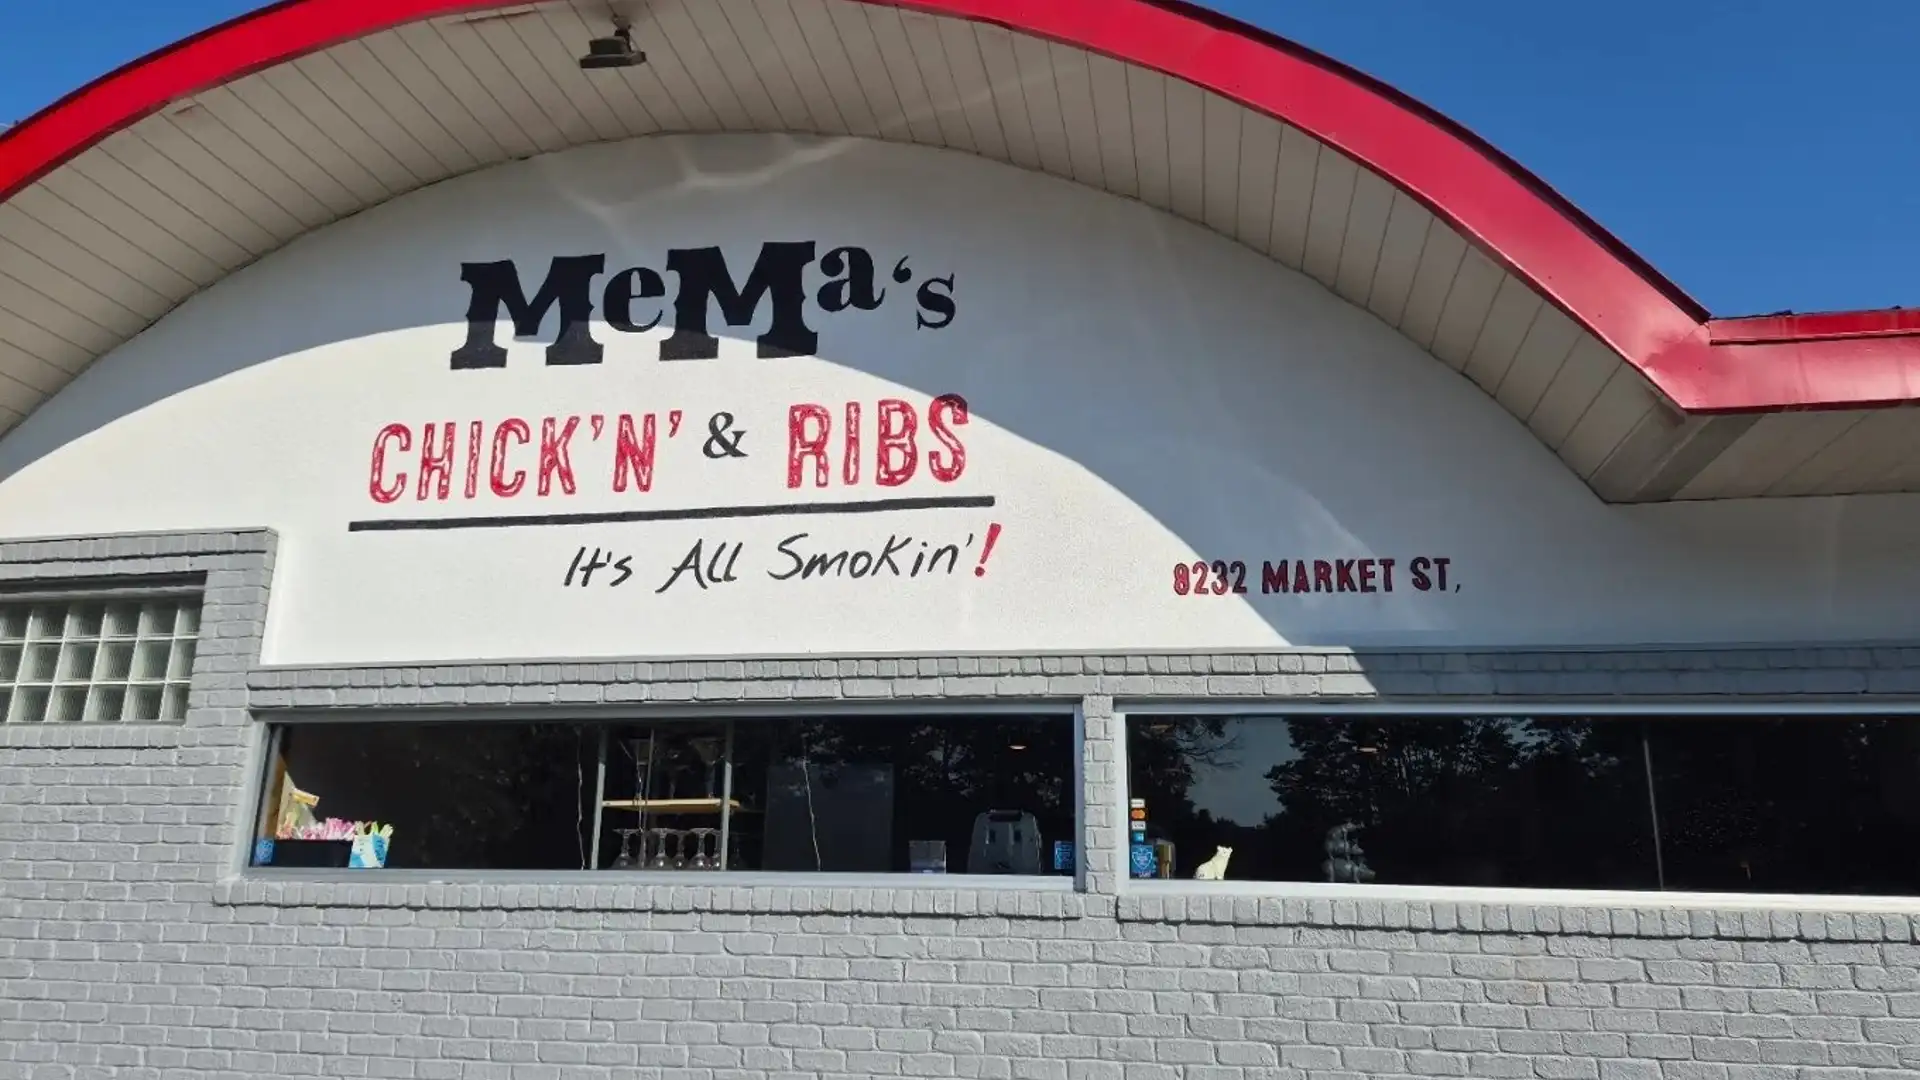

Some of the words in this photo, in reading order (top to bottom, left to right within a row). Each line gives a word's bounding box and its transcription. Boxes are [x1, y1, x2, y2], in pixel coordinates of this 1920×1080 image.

[450, 241, 956, 369] MeMa's
[369, 410, 682, 503] CHICK'N'
[702, 412, 748, 458] &
[787, 394, 969, 488] RIBS
[564, 546, 634, 587] It's
[655, 538, 743, 592] All
[1173, 560, 1248, 595] 8232
[1261, 558, 1396, 594] MARKET
